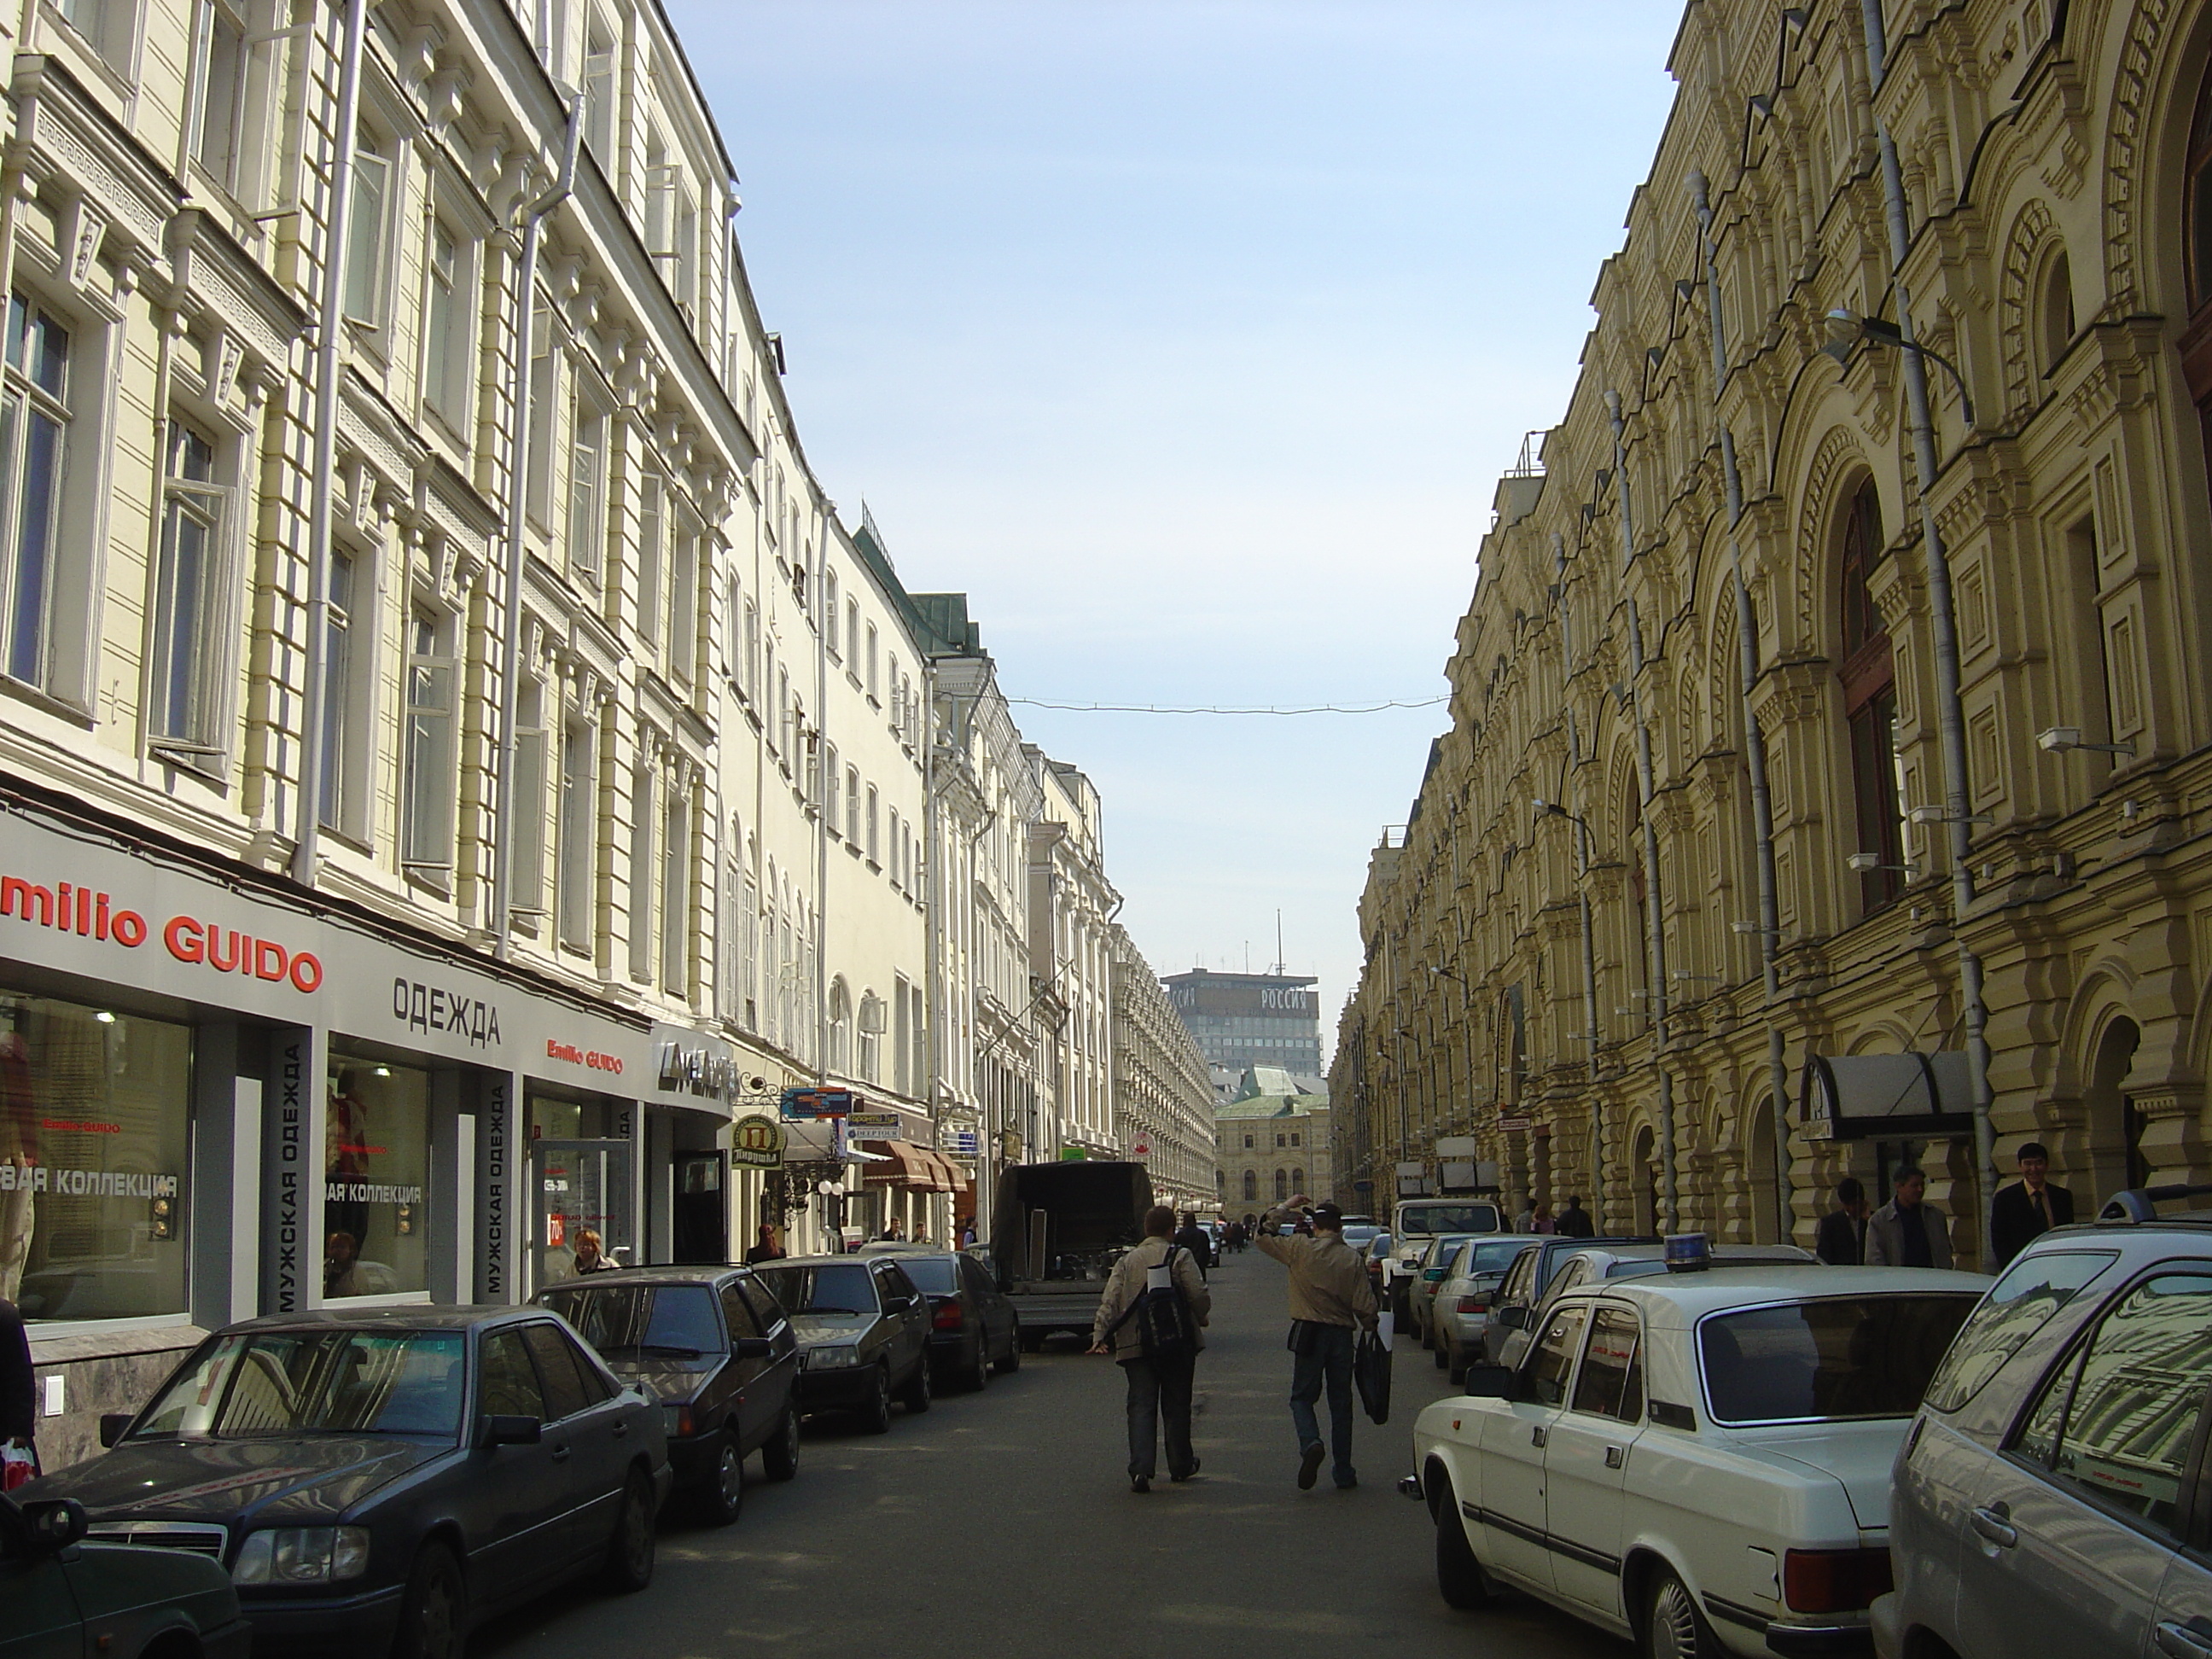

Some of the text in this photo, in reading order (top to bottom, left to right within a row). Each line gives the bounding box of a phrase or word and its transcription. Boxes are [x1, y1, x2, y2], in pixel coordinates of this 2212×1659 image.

[164, 916, 323, 993] GUIDO
[393, 977, 501, 1049] ОДЕЖДА
[1167, 987, 1195, 1009] ССИЯ
[1261, 989, 1307, 1010] РОССИЯ
[548, 1039, 623, 1074] Emilio GUIDO
[43, 1119, 120, 1133] Emilio GUIDO
[620, 1111, 630, 1139] ДА
[733, 1148, 777, 1163] Пирушка
[0, 1165, 178, 1200] ВАЯ КОЛЛЕКЦИЯ
[280, 1044, 300, 1313] МУЖСКАЯ ОДЕЖДА
[488, 1085, 504, 1294] МУЖСКАЯ ОДЕЖДА
[349, 1185, 422, 1204] КОЛЛЕКЦИЯ
